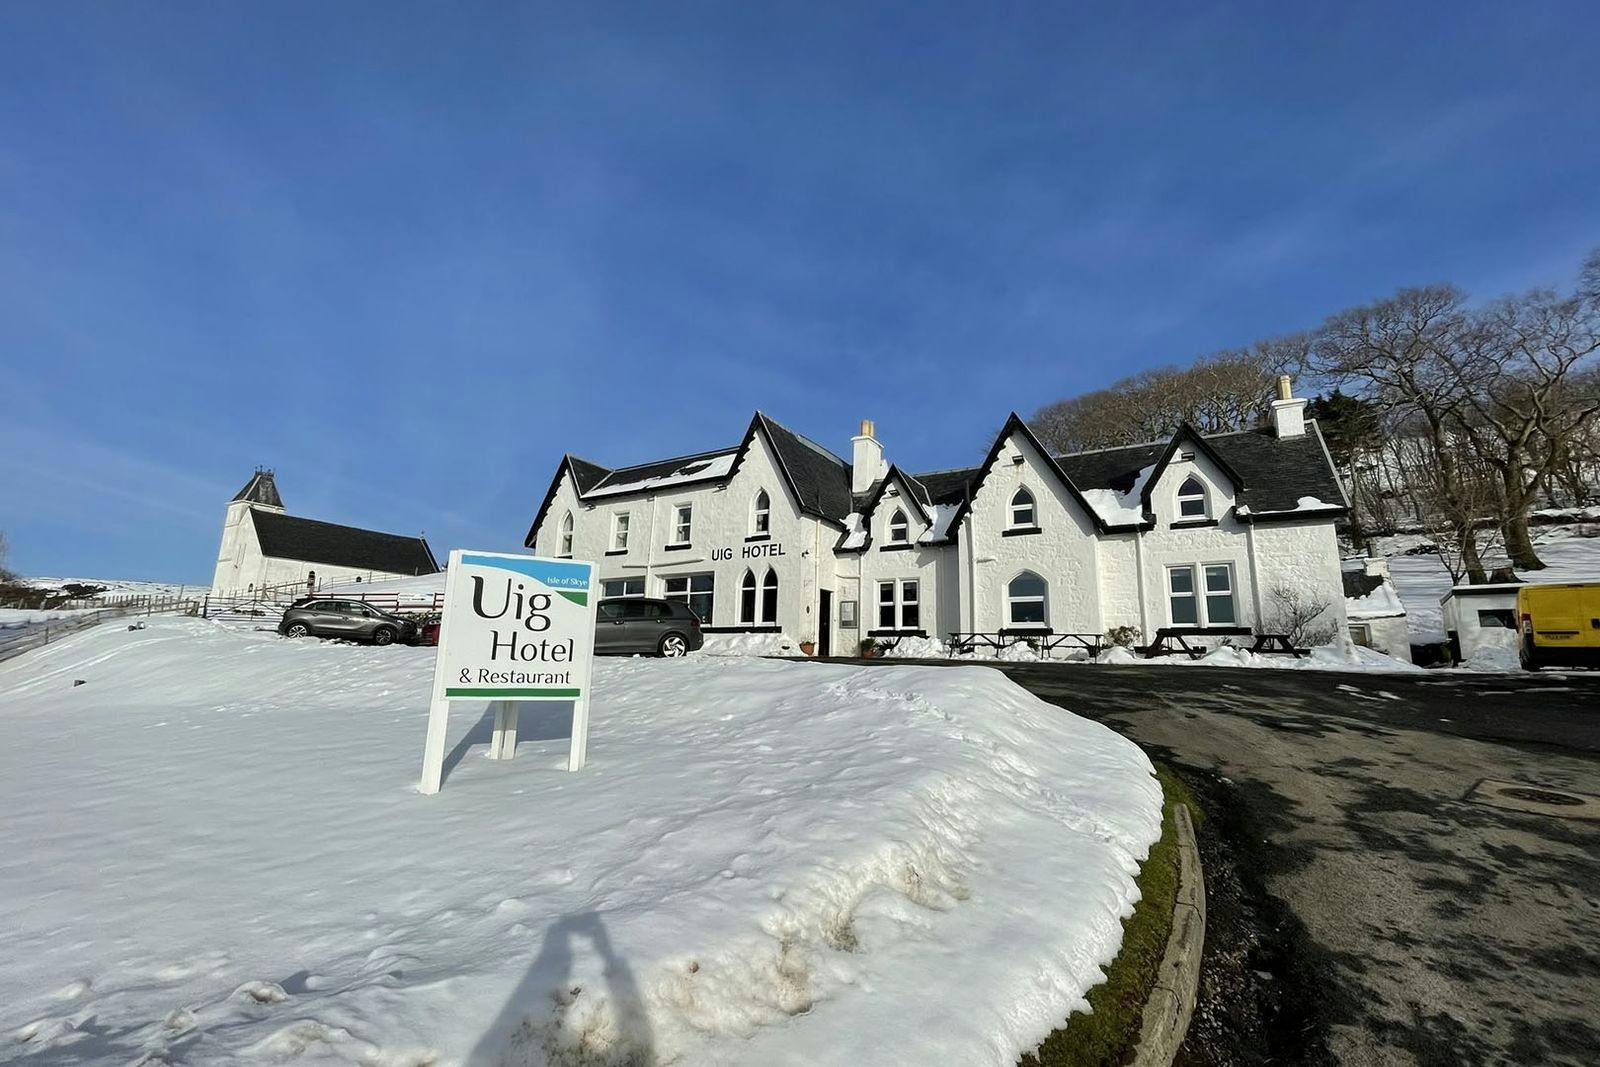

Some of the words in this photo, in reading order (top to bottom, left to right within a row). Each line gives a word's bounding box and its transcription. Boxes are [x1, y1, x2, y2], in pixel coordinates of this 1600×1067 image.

[711, 548, 733, 561] UIG
[742, 543, 786, 559] HOTEL
[547, 576, 560, 584] Isle
[560, 577, 570, 585] of
[570, 578, 588, 587] Skye
[470, 575, 552, 632] Uig
[490, 630, 574, 662] Hotel
[459, 667, 473, 684] &
[478, 668, 571, 684] Restaurant
